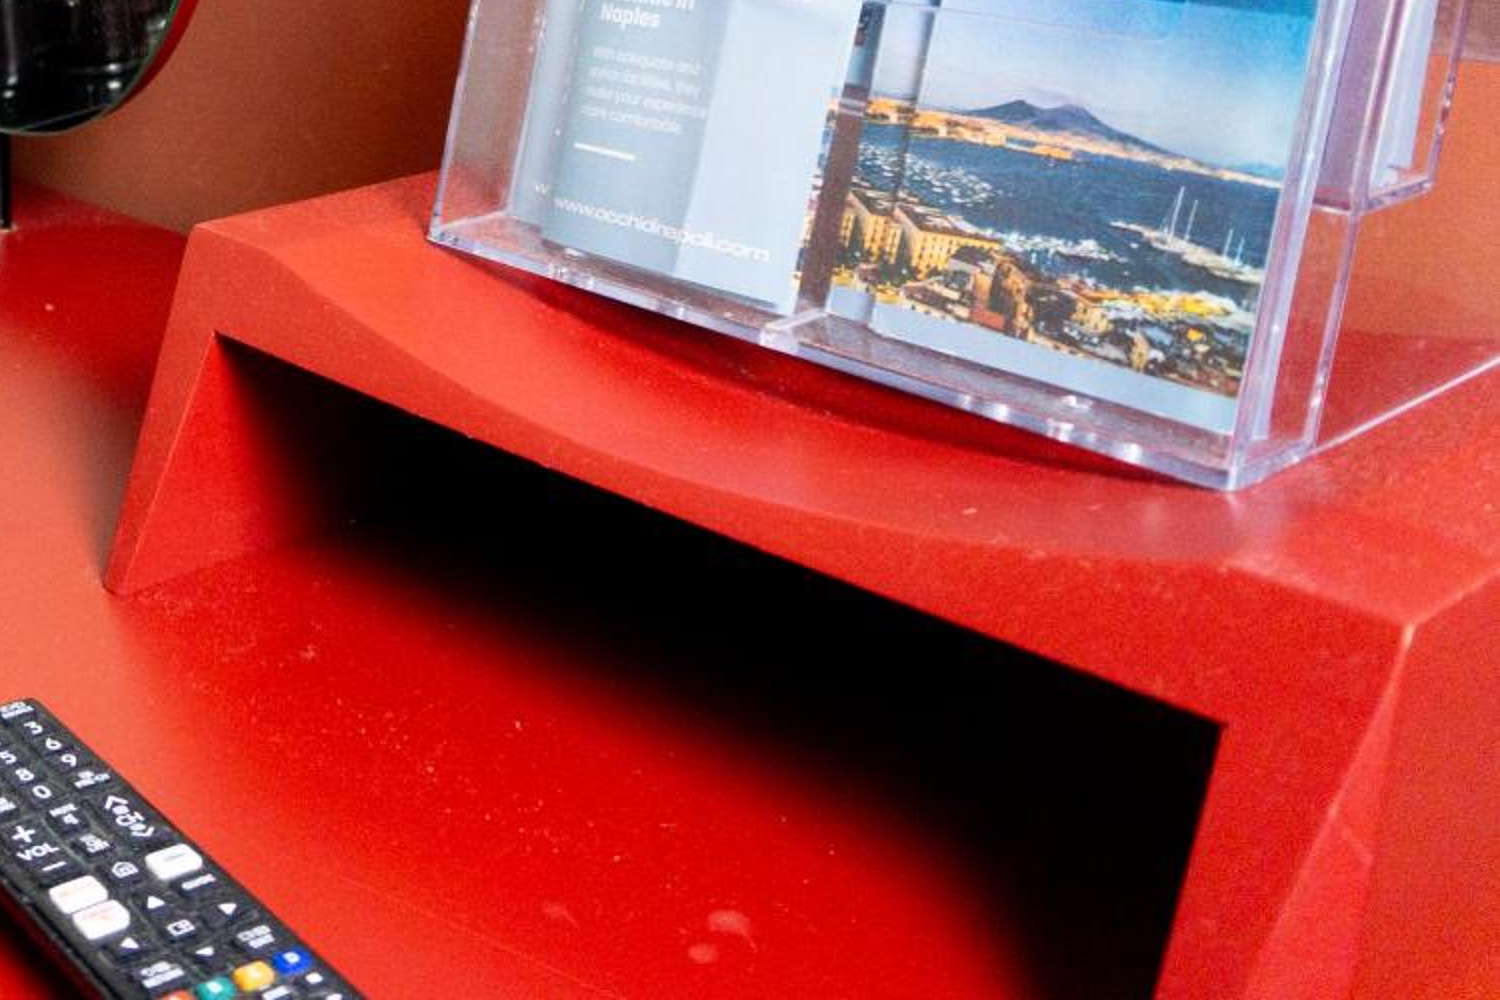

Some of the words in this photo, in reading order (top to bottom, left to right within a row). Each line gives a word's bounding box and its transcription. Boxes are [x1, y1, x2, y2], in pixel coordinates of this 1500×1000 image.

[23, 721, 43, 735] 3
[45, 737, 62, 751] 6
[15, 768, 35, 781] 8
[61, 753, 77, 767] 9
[16, 842, 60, 862] VOL
